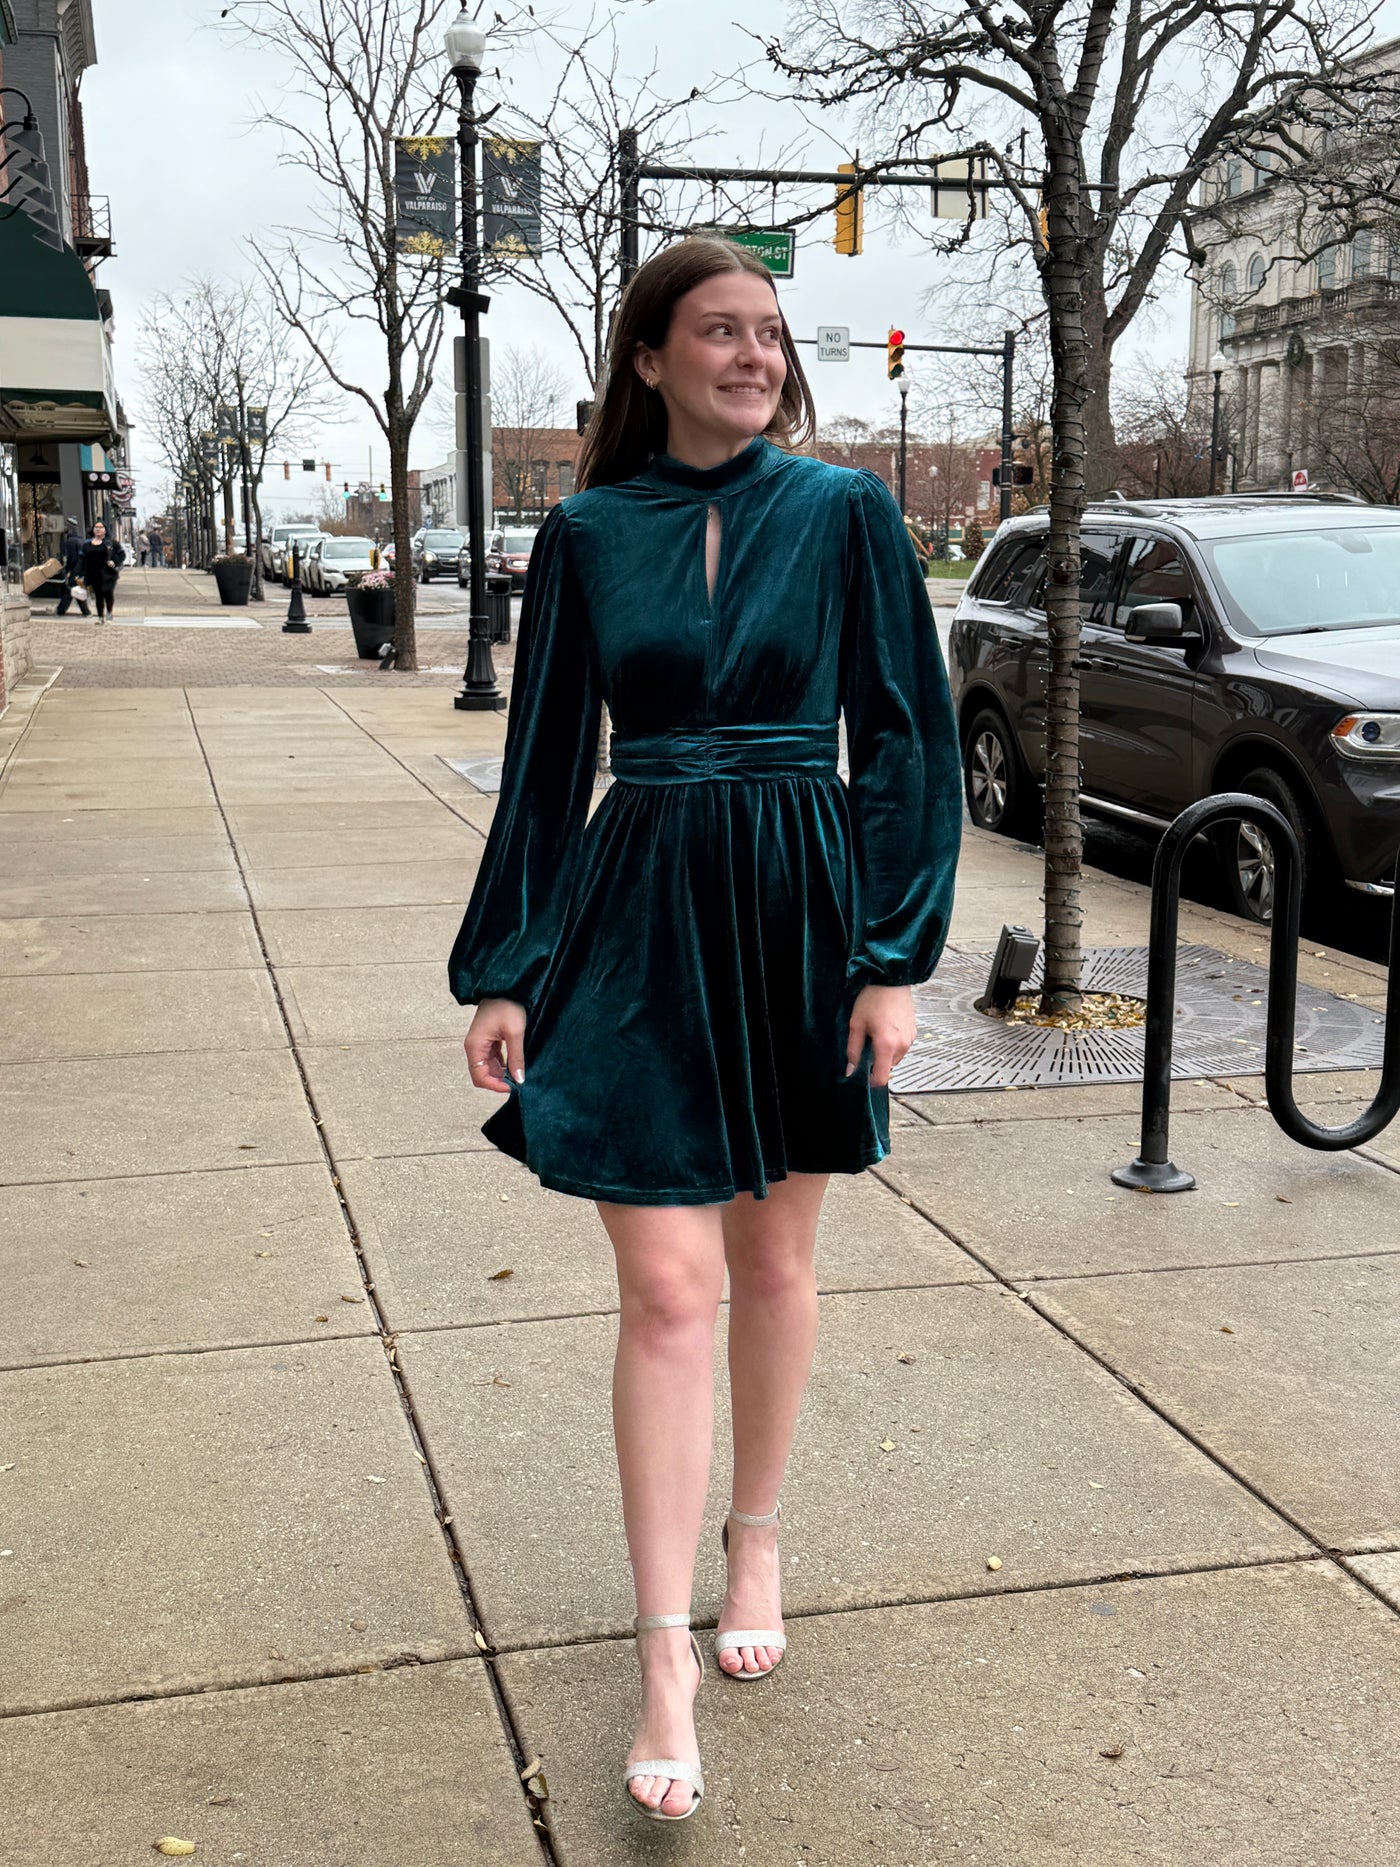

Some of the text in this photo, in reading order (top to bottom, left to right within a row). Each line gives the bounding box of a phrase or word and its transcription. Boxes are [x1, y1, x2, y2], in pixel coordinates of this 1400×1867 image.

[405, 201, 448, 211] VALPARAISO
[774, 246, 788, 260] ST
[826, 332, 841, 343] NO
[820, 347, 848, 357] TURNS
